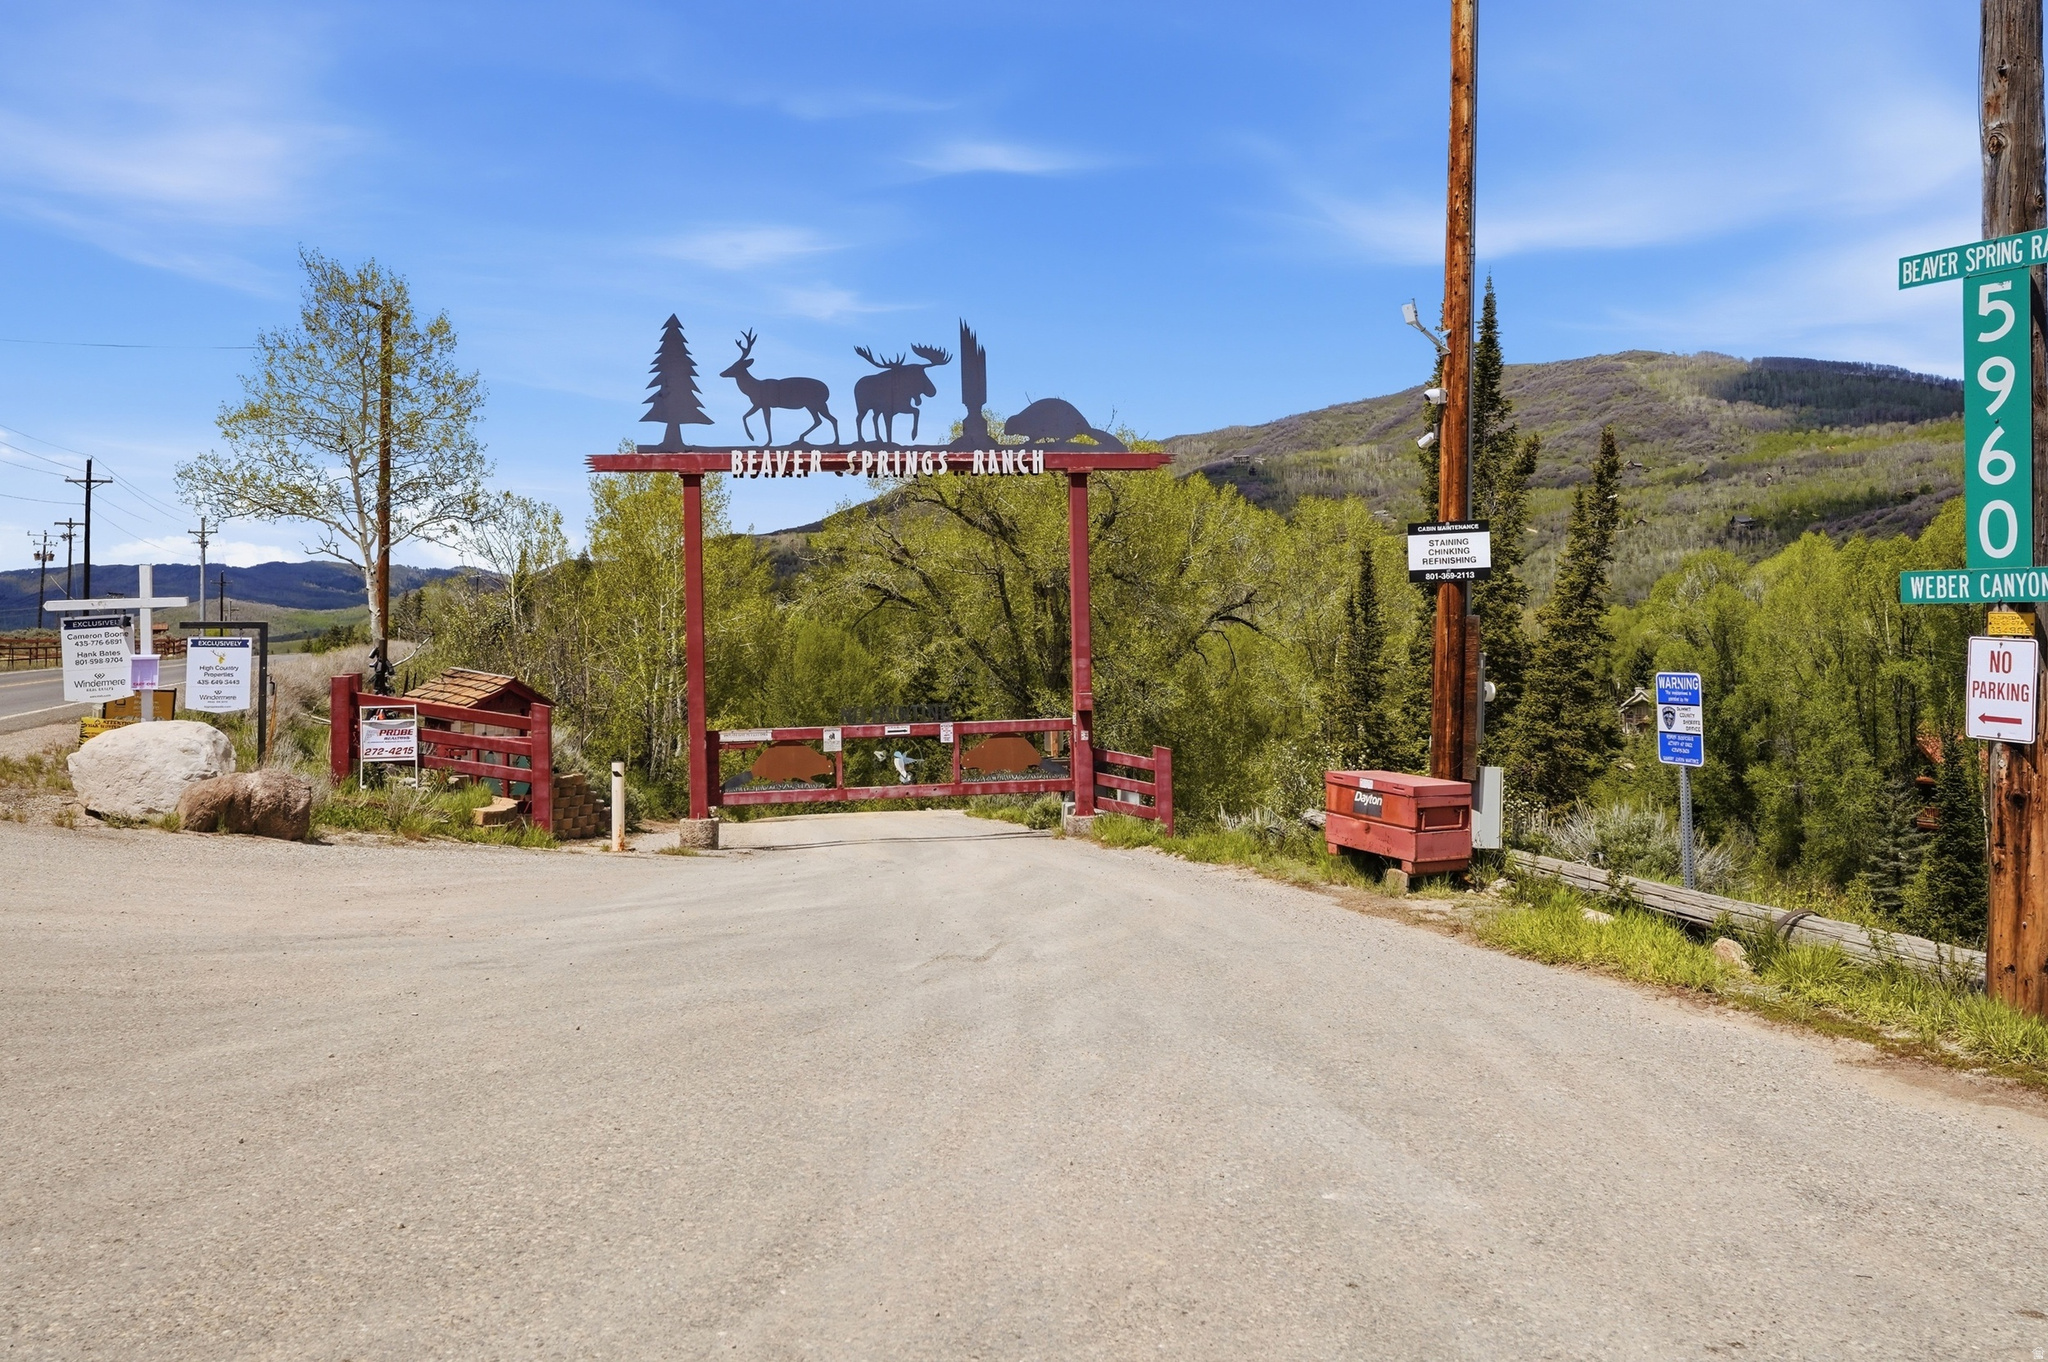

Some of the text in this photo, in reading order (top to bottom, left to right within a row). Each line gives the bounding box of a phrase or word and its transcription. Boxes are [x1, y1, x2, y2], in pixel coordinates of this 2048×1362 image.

[1903, 252, 1958, 285] BEAVER
[1965, 238, 2023, 273] SPRING
[731, 449, 1044, 475] BEAVER SPRINGS RANCH
[1437, 523, 1479, 531] MAINTENANCE
[1428, 538, 1469, 547] STAINING
[1428, 547, 1470, 556] CHINKING
[1422, 556, 1477, 565] REFINISHING
[1910, 572, 2048, 600] WEBER CANYON
[1989, 650, 2012, 674] NO
[74, 679, 126, 689] Windermere
[1658, 676, 1699, 690] WARNING
[1972, 680, 2030, 702] PARKING
[364, 747, 414, 756] 272-4215
[1354, 790, 1383, 806] Dayton
